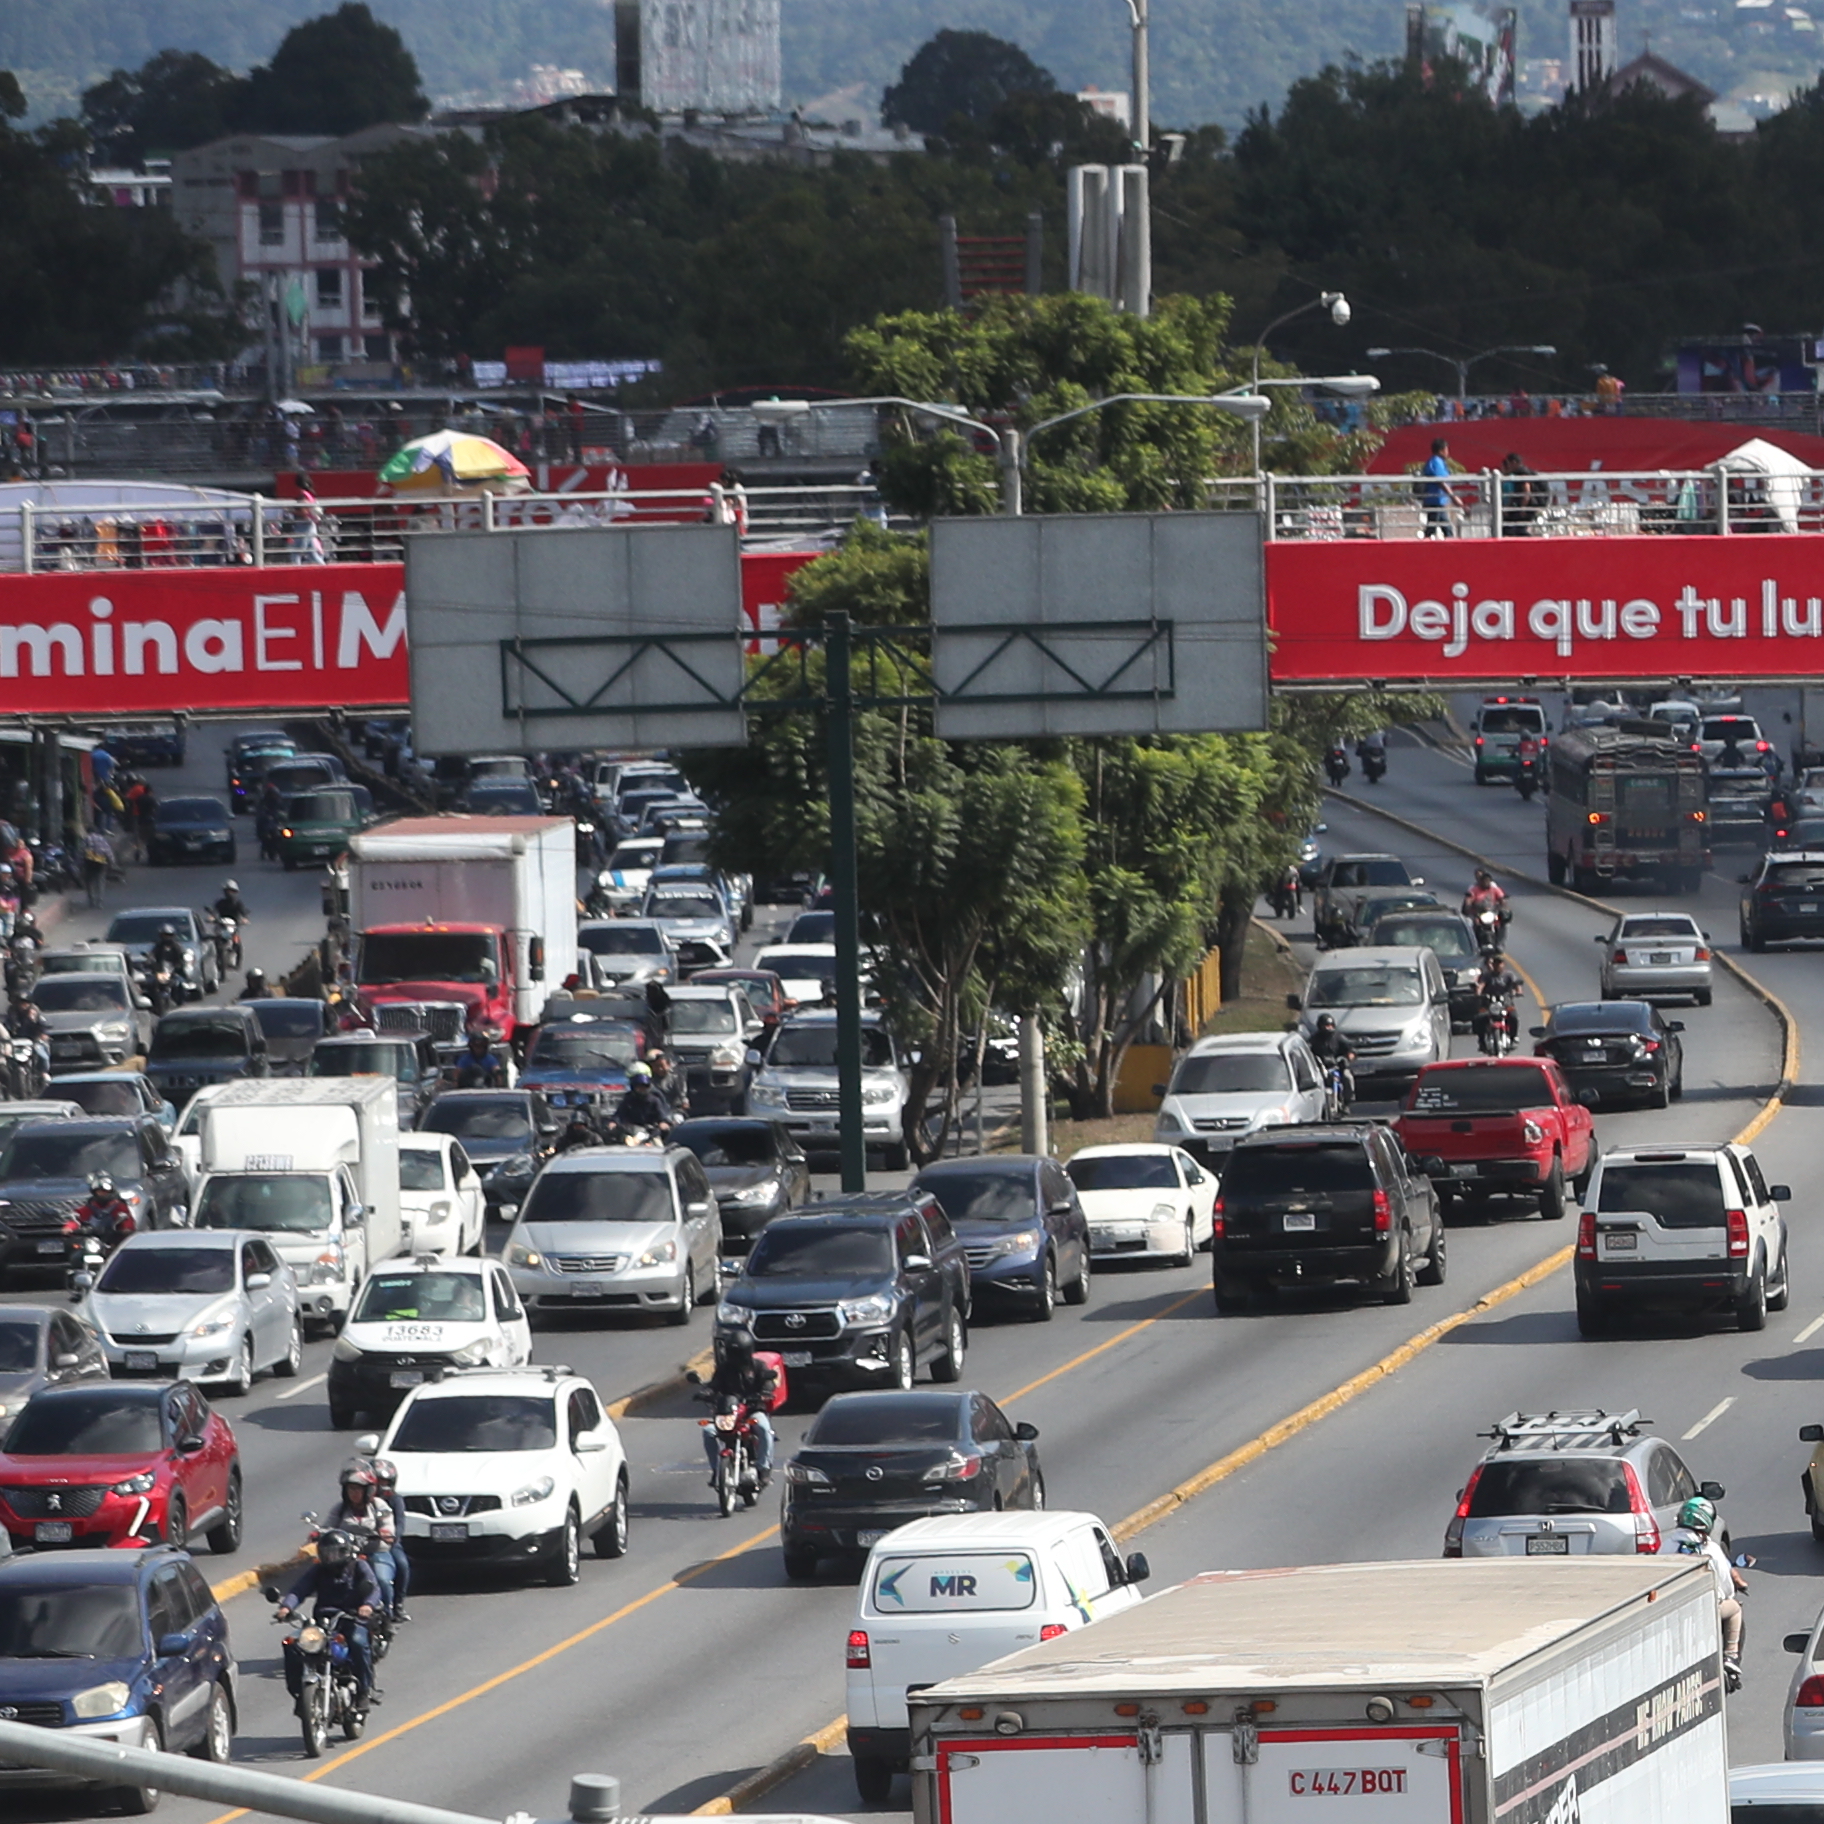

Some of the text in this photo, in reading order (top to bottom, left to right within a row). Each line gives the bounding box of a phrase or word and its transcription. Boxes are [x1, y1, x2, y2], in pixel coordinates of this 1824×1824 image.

[1358, 582, 1515, 660] Deja
[1527, 599, 1662, 656] que
[1674, 584, 1748, 641] tu
[930, 1575, 978, 1598] MR
